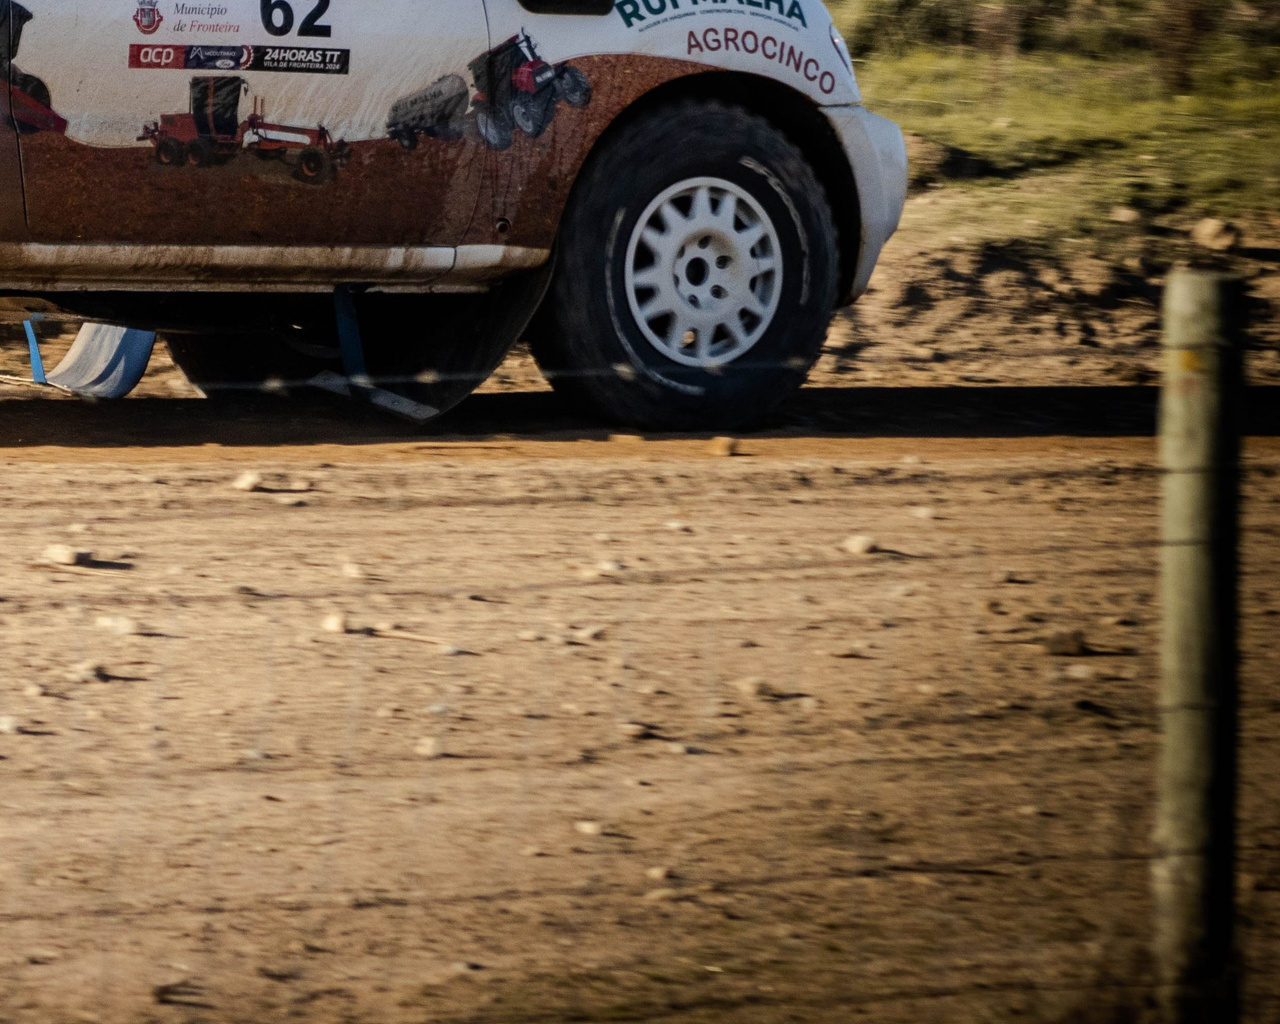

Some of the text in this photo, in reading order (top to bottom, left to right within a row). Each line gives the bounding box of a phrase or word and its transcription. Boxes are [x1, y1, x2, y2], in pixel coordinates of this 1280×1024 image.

[173, 2, 227, 16] Município
[173, 19, 240, 33] de Fronteira
[140, 47, 174, 65] acp
[325, 50, 340, 63] TT
[686, 26, 836, 95] AGROCINCO
